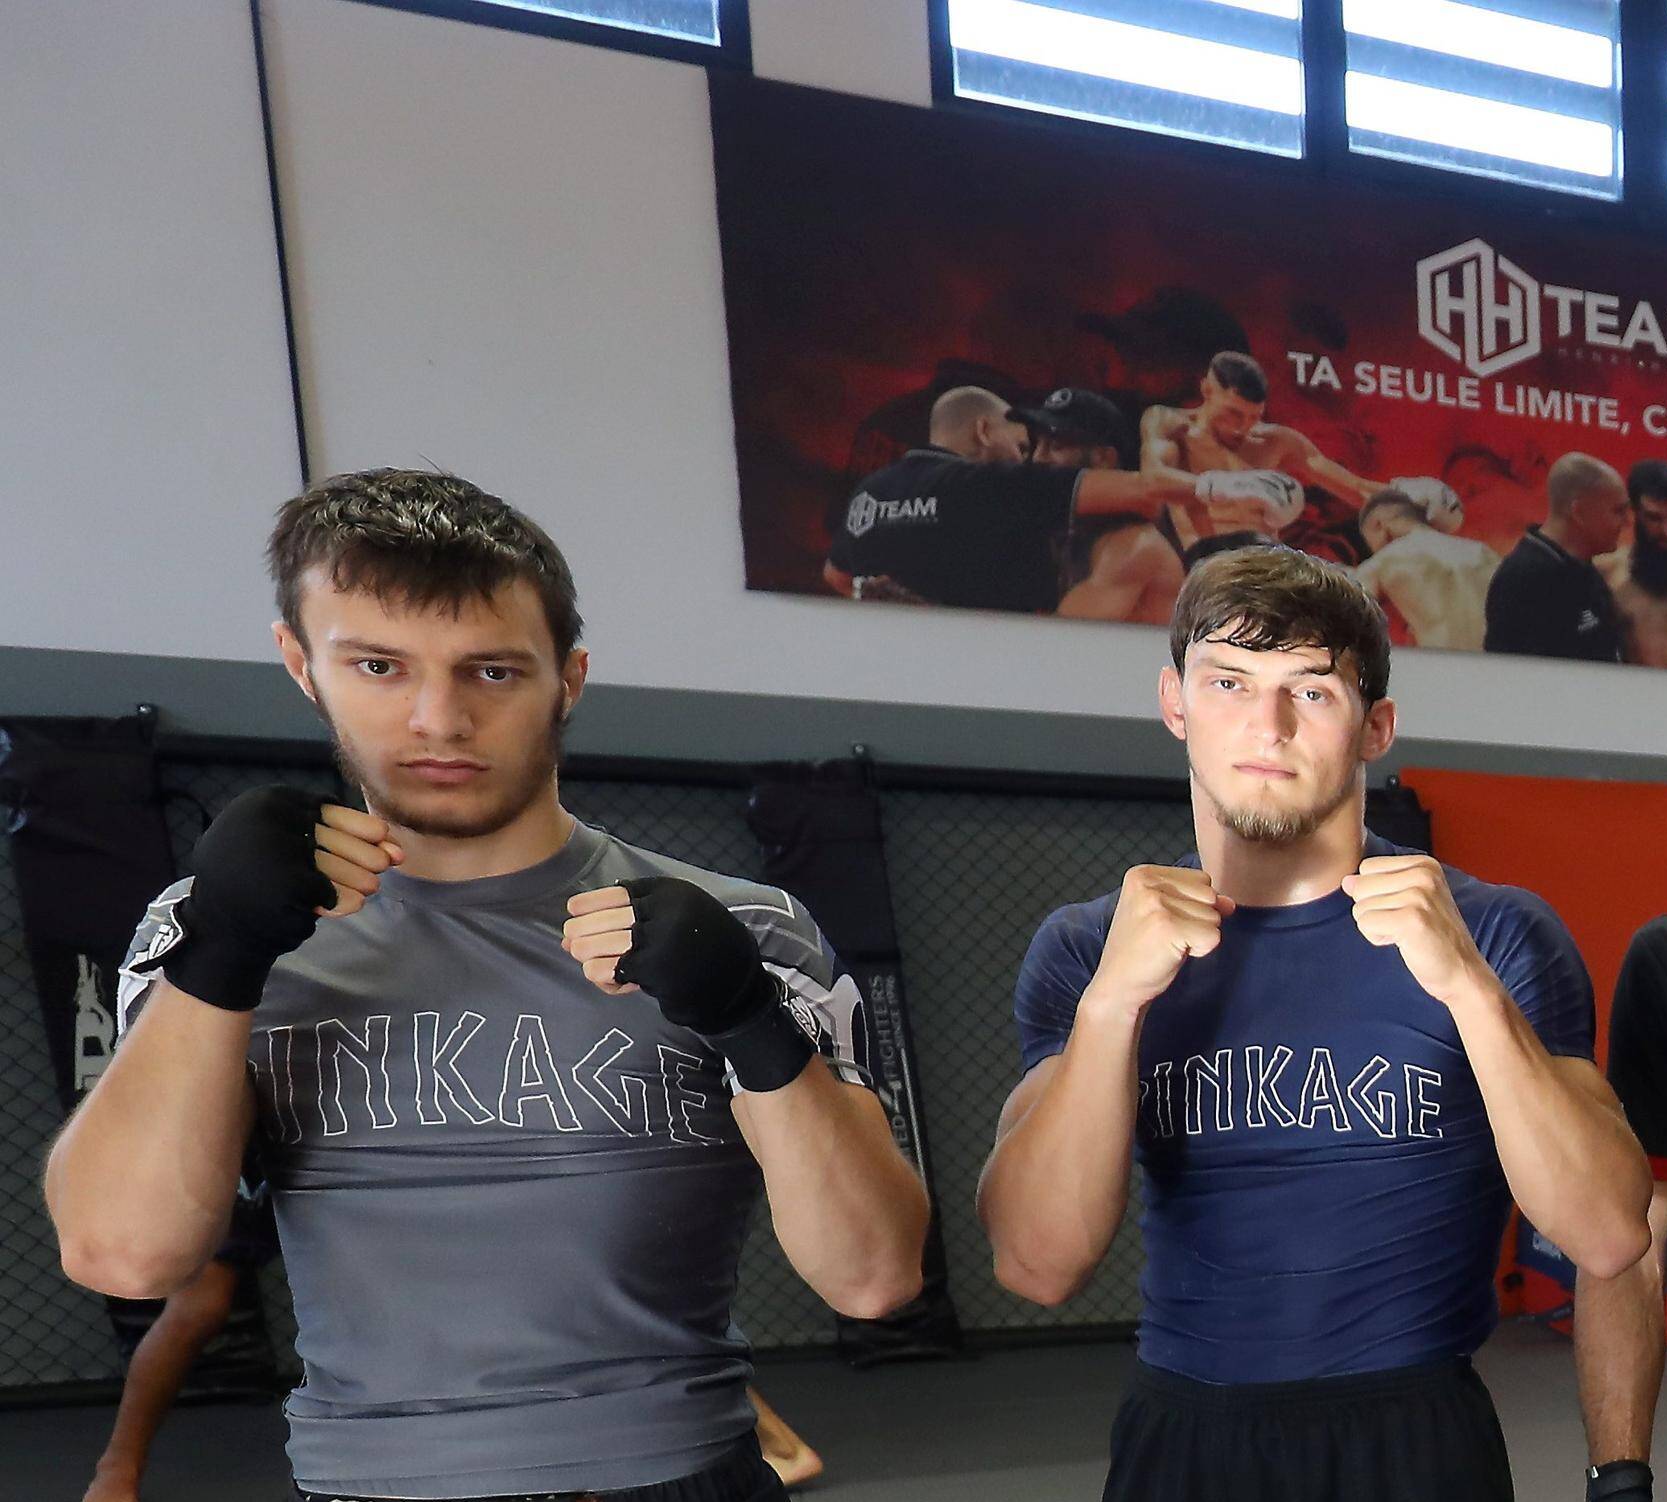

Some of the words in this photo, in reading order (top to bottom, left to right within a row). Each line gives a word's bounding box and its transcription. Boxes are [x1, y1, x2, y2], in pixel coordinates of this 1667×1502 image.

[1287, 351, 1341, 391] TA
[1354, 361, 1481, 410] SEULE
[1496, 382, 1629, 436] LIMITE,
[877, 497, 938, 519] TEAM
[252, 1008, 725, 1146] INKAGE
